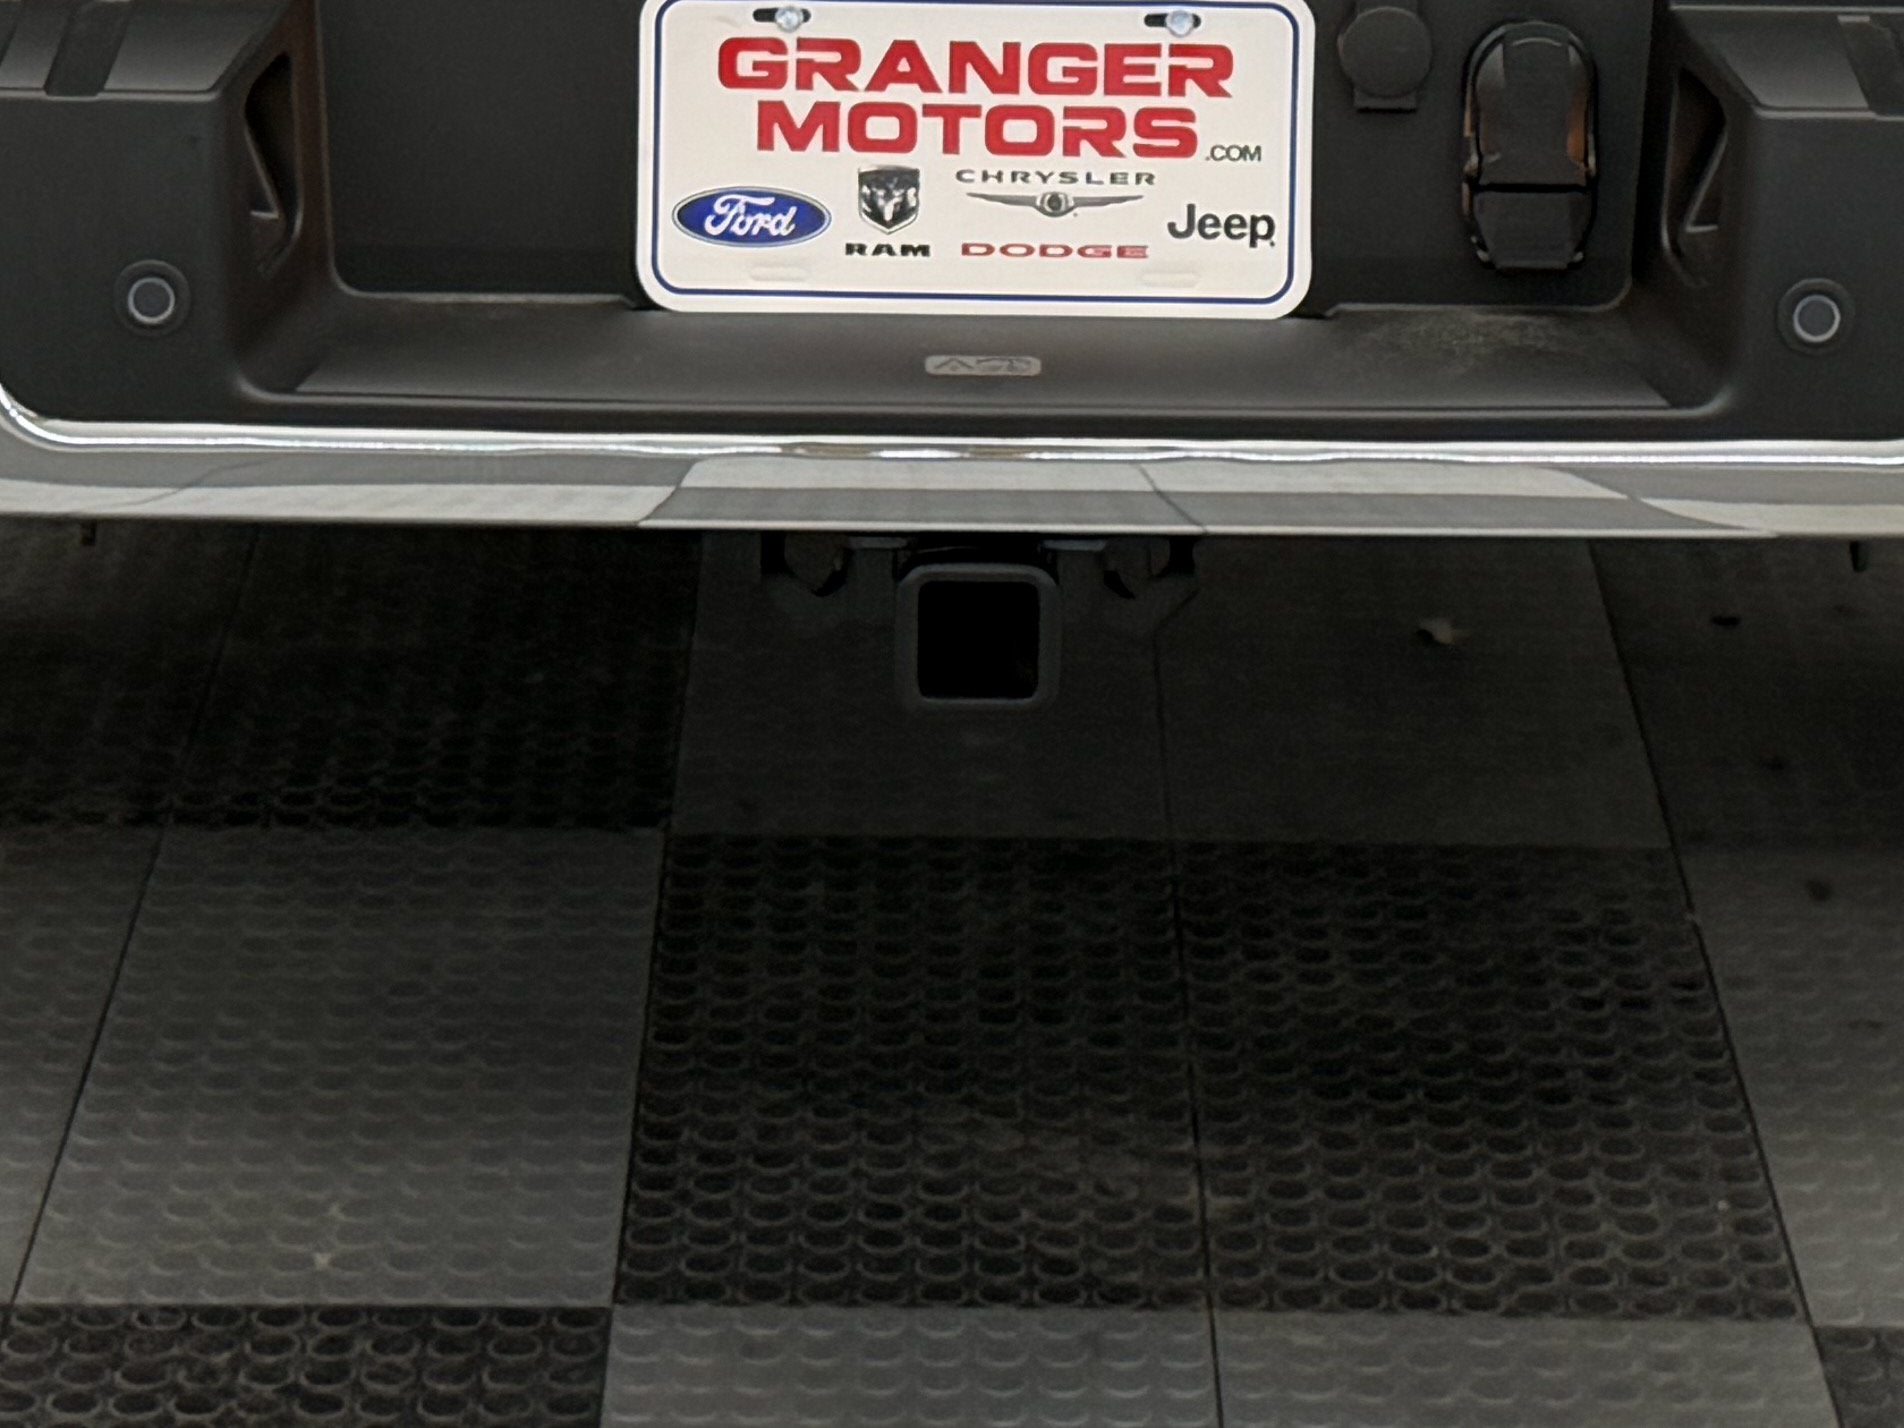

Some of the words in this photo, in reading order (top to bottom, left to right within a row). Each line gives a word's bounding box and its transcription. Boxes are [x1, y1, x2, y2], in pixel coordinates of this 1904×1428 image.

[718, 36, 1234, 98] GRANGER
[757, 101, 1198, 159] MOTORS
[1205, 144, 1262, 162] .COM
[955, 169, 1156, 186] CHRYSLER
[704, 194, 798, 236] Ford
[1167, 203, 1276, 248] Jeep
[845, 242, 931, 257] RAM
[961, 242, 1149, 259] DODGE
